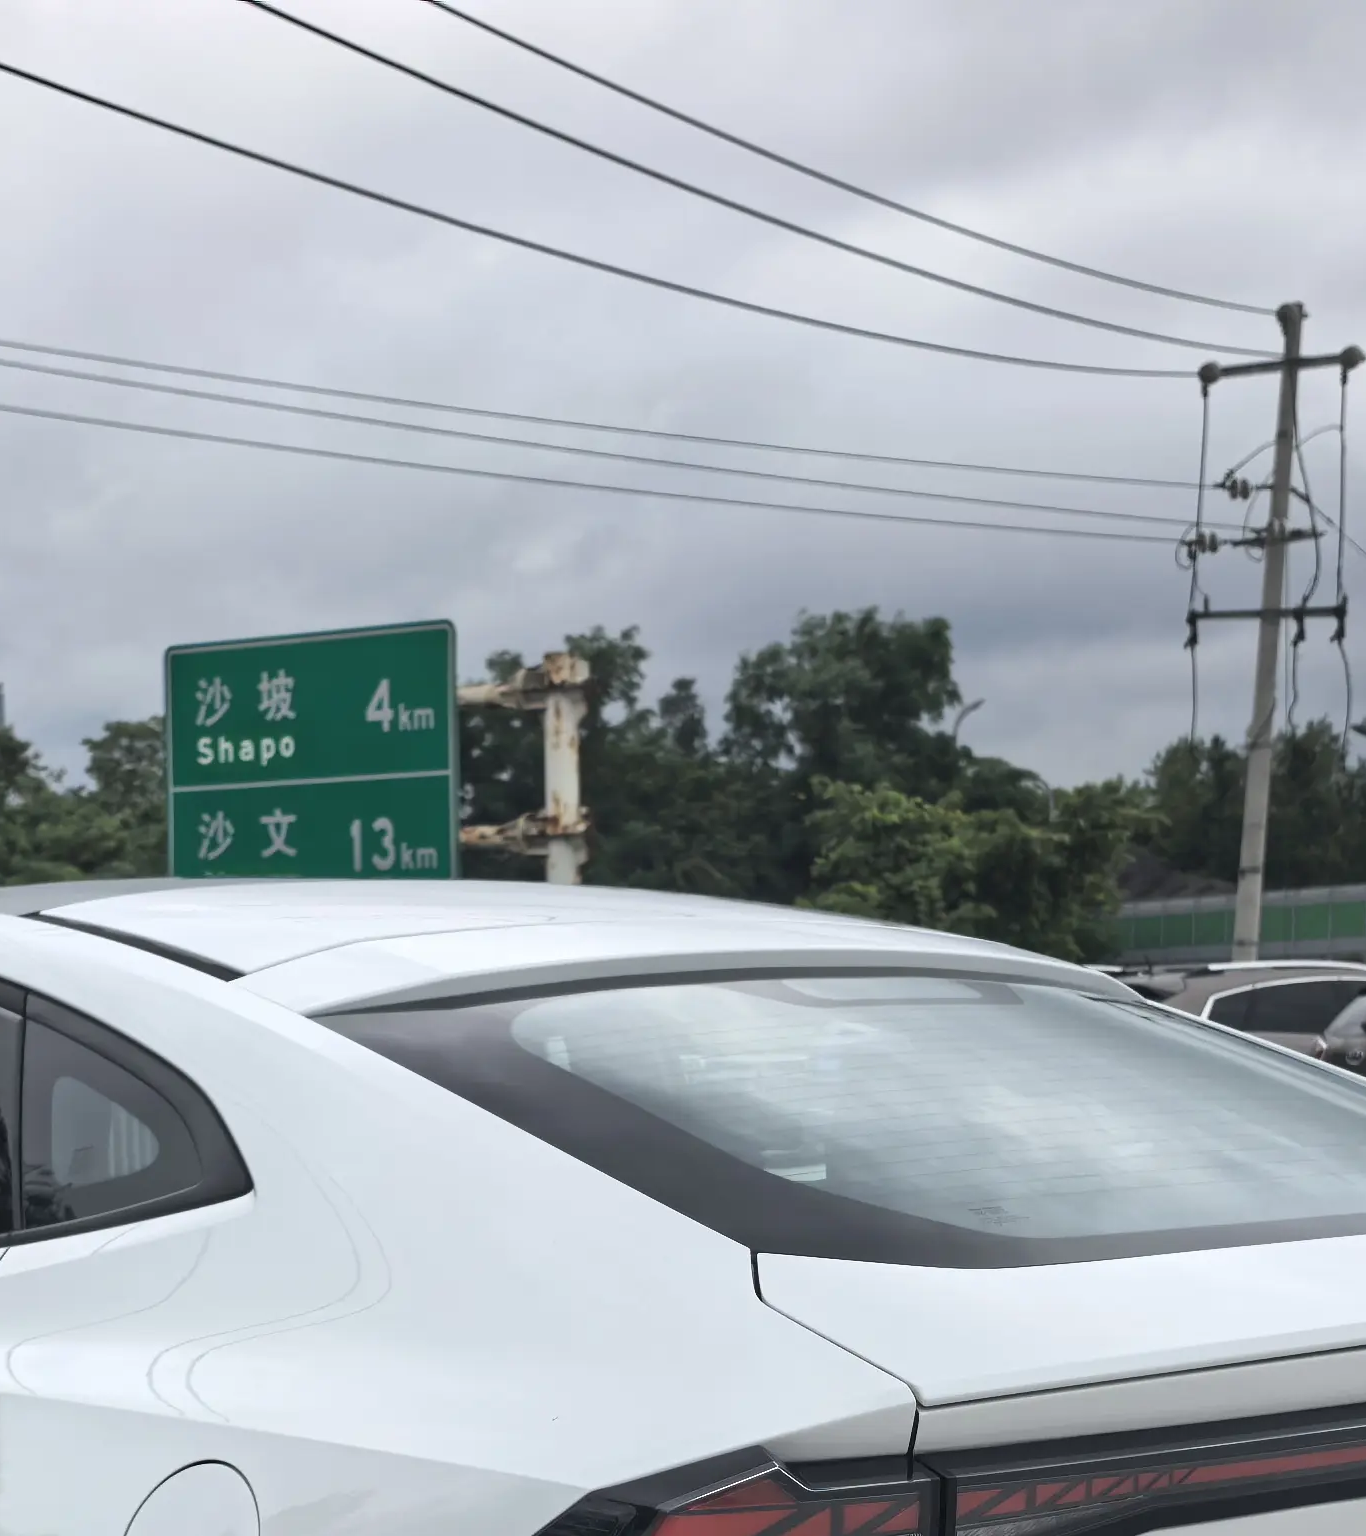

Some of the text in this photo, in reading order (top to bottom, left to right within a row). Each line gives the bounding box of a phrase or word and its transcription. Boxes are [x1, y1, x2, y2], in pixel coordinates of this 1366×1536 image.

[195, 669, 296, 727] 沙坡
[196, 735, 296, 766] Shapo
[197, 808, 298, 860] 沙文
